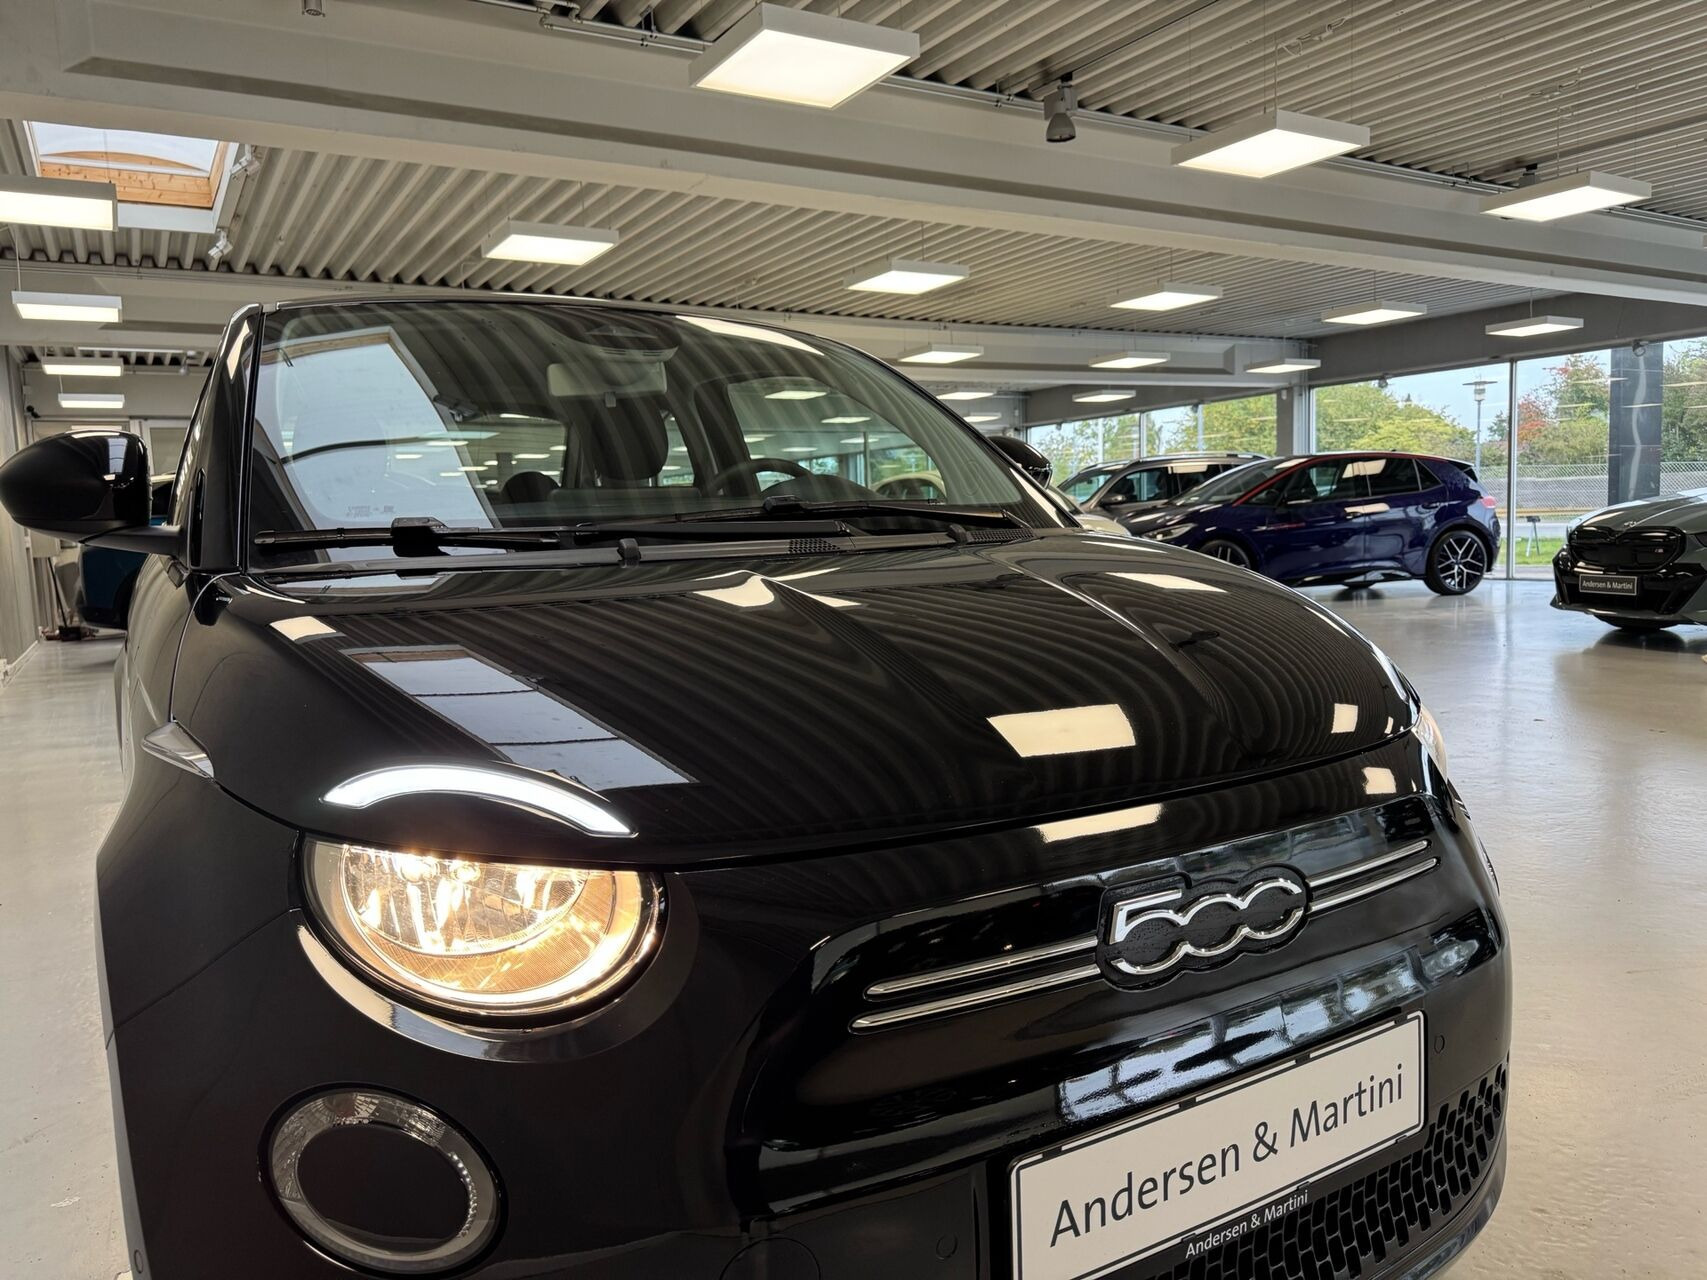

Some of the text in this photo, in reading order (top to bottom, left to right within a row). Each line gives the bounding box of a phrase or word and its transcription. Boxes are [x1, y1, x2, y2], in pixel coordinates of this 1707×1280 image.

[1582, 580, 1606, 588] Andersen
[1612, 582, 1633, 590] Martini
[1109, 877, 1304, 975] 500
[1049, 1063, 1403, 1248] Andersen & Martini
[1185, 1189, 1308, 1259] Andersen & Martini
